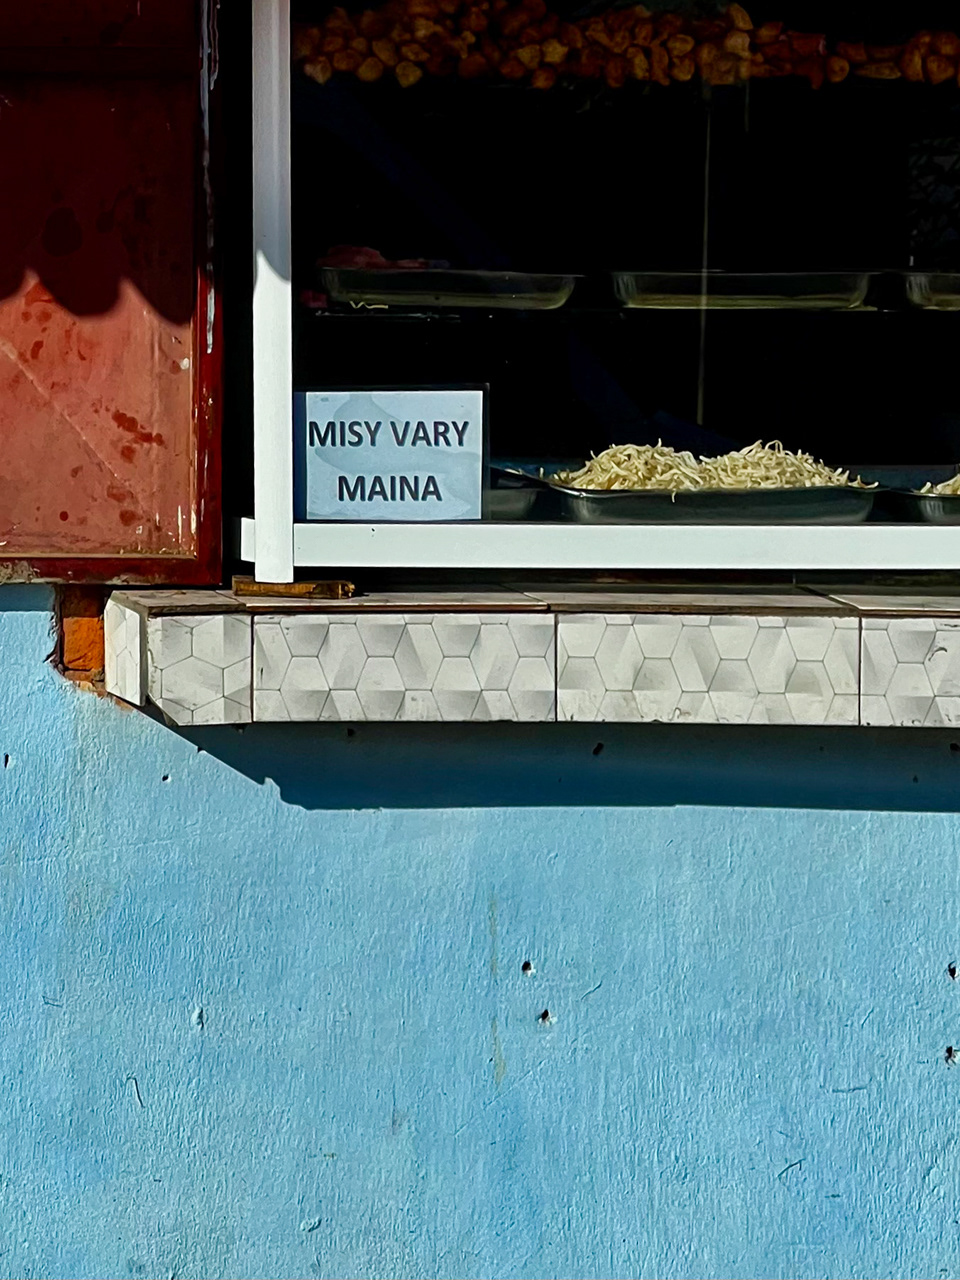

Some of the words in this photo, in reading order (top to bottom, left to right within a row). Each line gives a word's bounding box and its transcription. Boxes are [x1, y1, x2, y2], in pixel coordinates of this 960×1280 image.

[309, 421, 382, 447] MISY
[390, 421, 469, 447] VARY
[338, 475, 443, 502] MAINA
